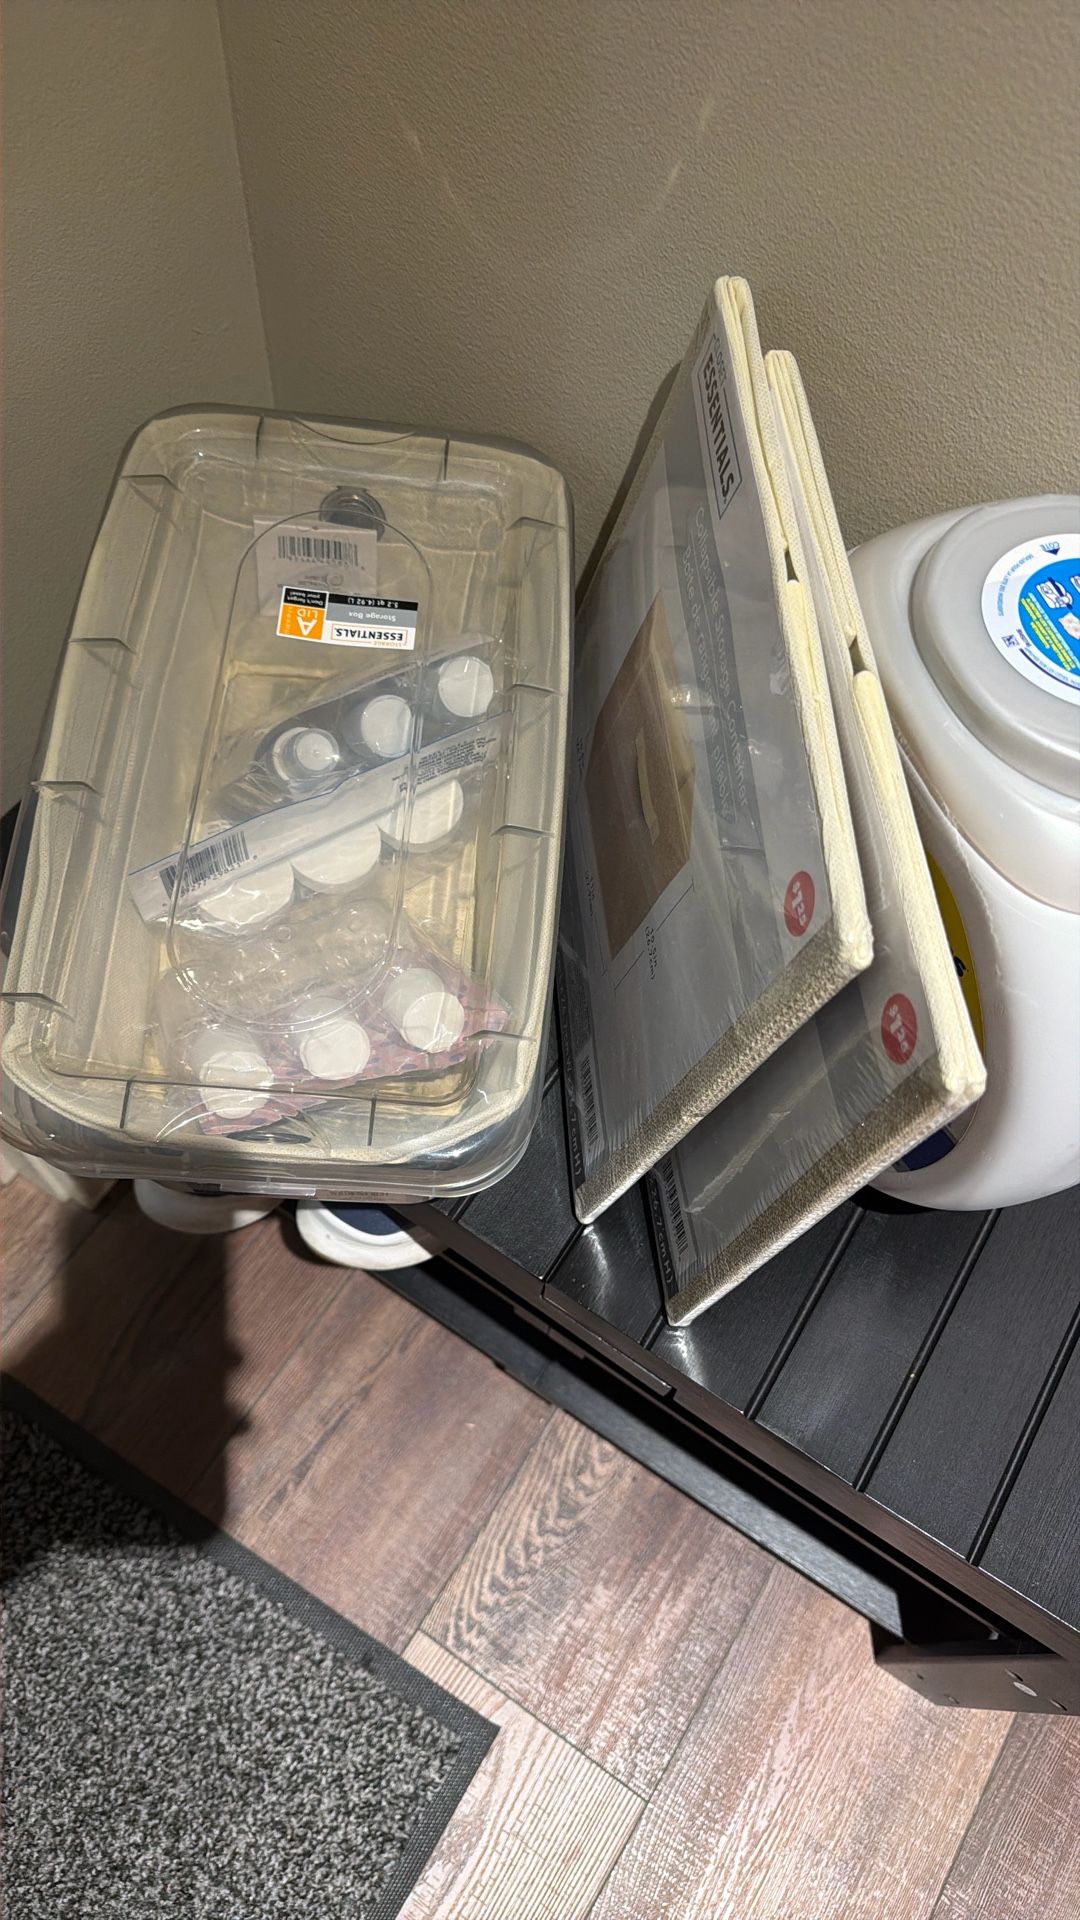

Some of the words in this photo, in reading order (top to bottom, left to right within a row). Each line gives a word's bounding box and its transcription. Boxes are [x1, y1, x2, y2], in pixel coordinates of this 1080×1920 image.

[387, 601, 399, 609] 5.2
[297, 609, 318, 619] LID
[348, 611, 364, 620] Box
[366, 612, 397, 622] Storage
[692, 603, 701, 630] de
[297, 616, 318, 636] A
[696, 507, 719, 614] Collapsible
[716, 613, 729, 697] Storage
[726, 700, 748, 806] Container
